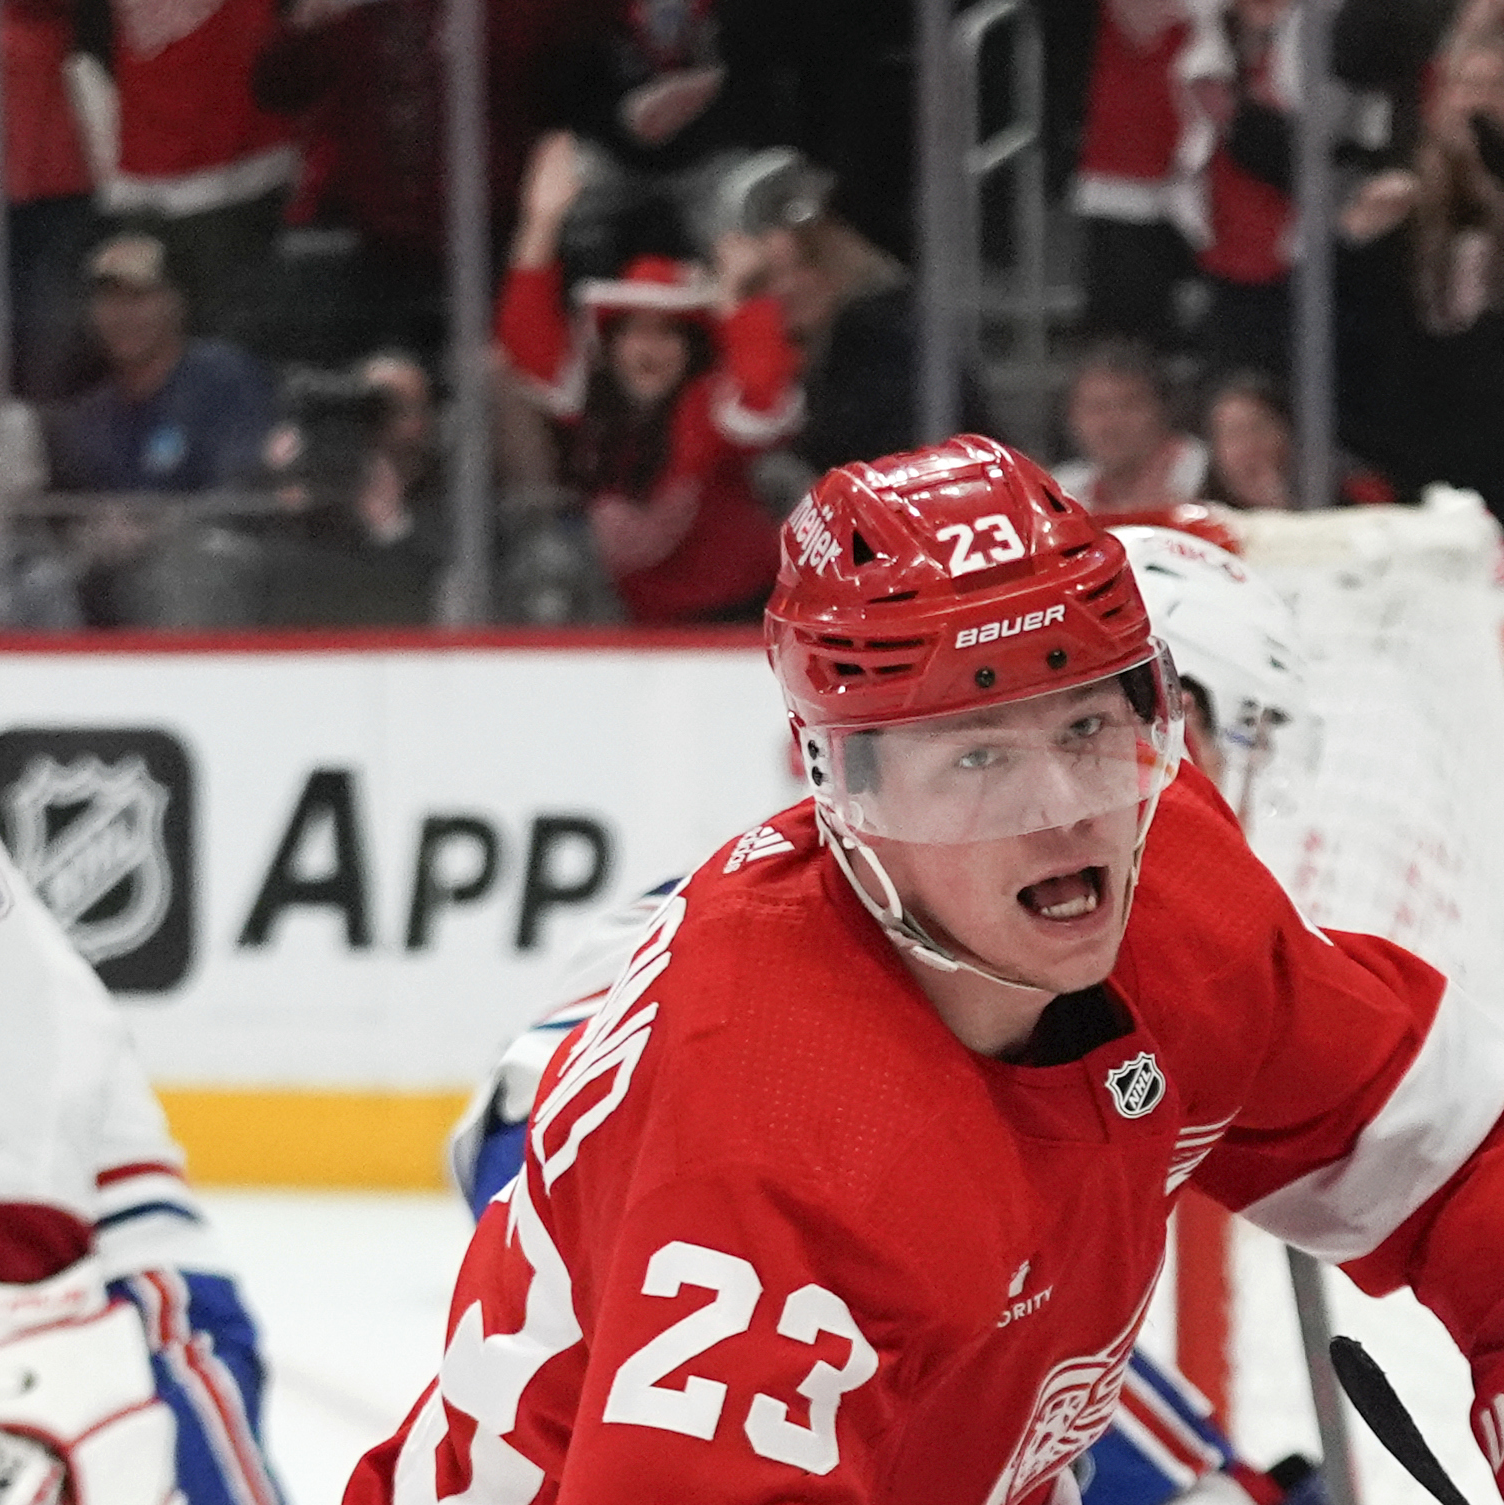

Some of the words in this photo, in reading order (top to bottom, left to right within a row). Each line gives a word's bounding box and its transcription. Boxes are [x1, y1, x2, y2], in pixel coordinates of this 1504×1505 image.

[937, 514, 1025, 577] 23
[955, 604, 1066, 649] BAUER
[1128, 1069, 1152, 1110] NHL
[602, 1240, 879, 1476] 23
